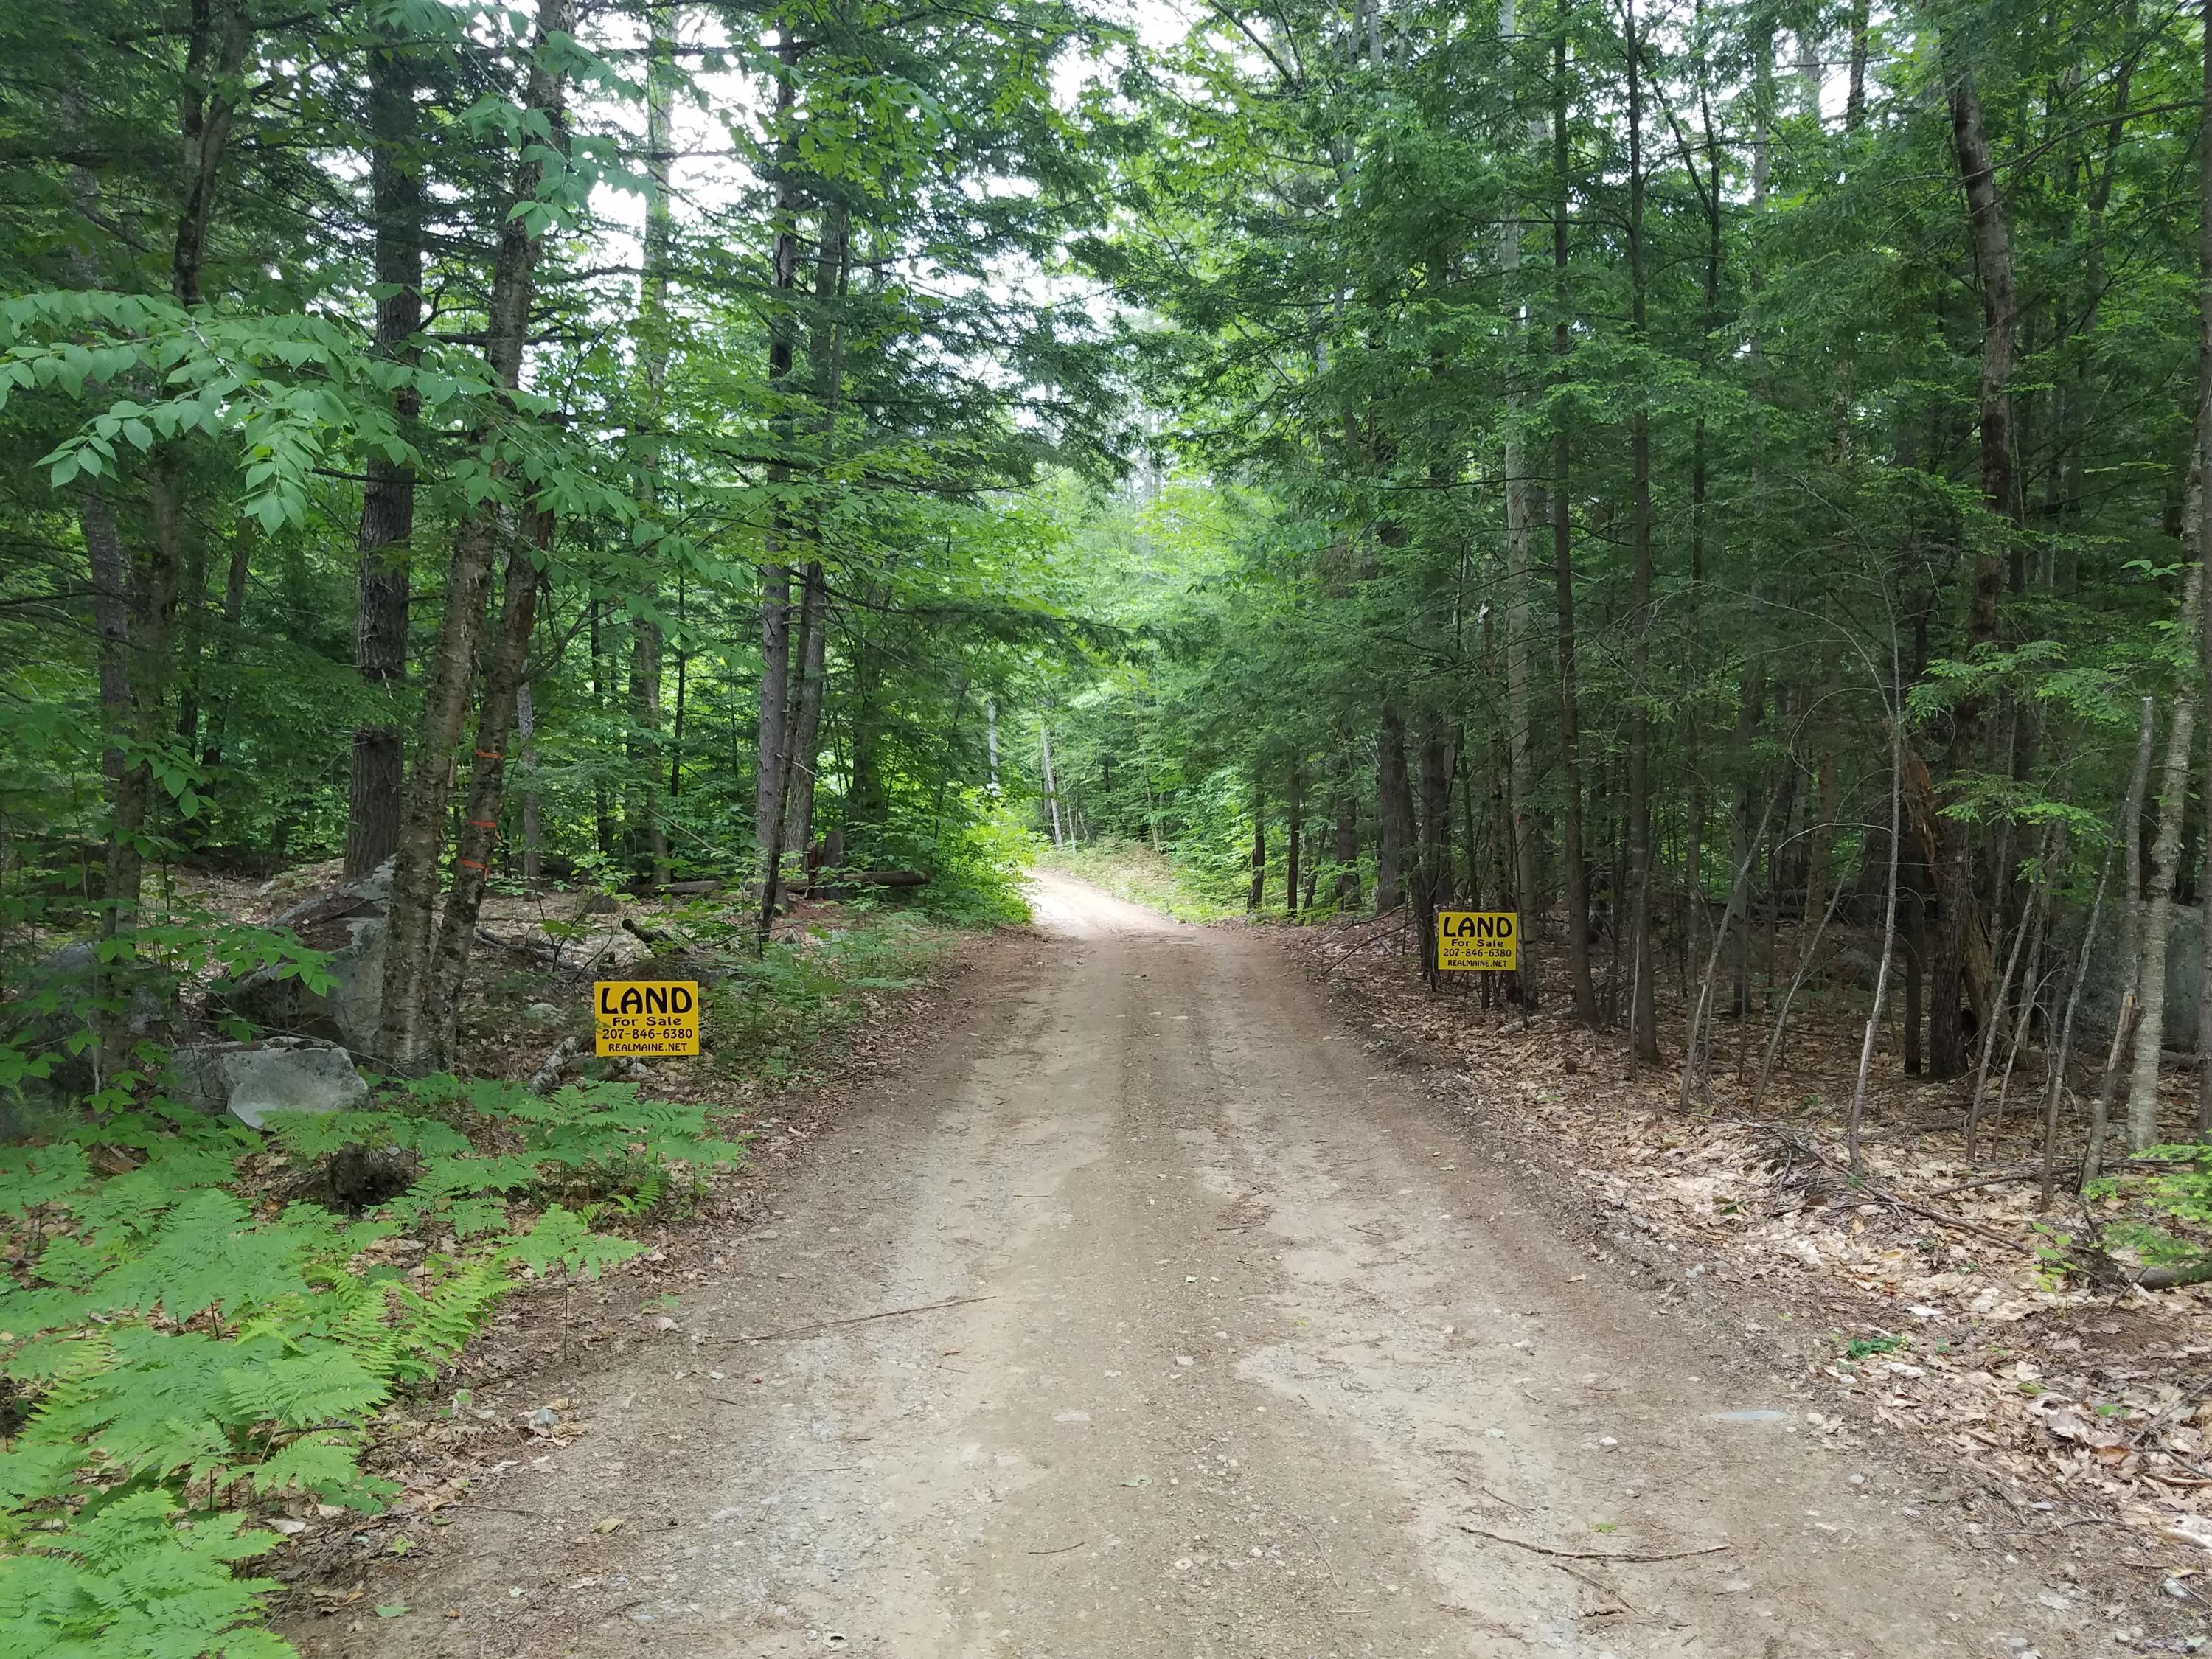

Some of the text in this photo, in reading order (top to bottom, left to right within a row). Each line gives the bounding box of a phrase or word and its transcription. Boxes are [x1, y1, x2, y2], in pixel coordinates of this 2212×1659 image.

[1443, 917, 1512, 938] LAND
[1451, 939, 1471, 947] For
[1443, 948, 1512, 957] 207-846-6380
[601, 987, 692, 1014] LAND
[612, 1016, 682, 1026] For Sale
[602, 1029, 692, 1039] 207-846-6380
[608, 1043, 687, 1052] REALMAINE.NET
